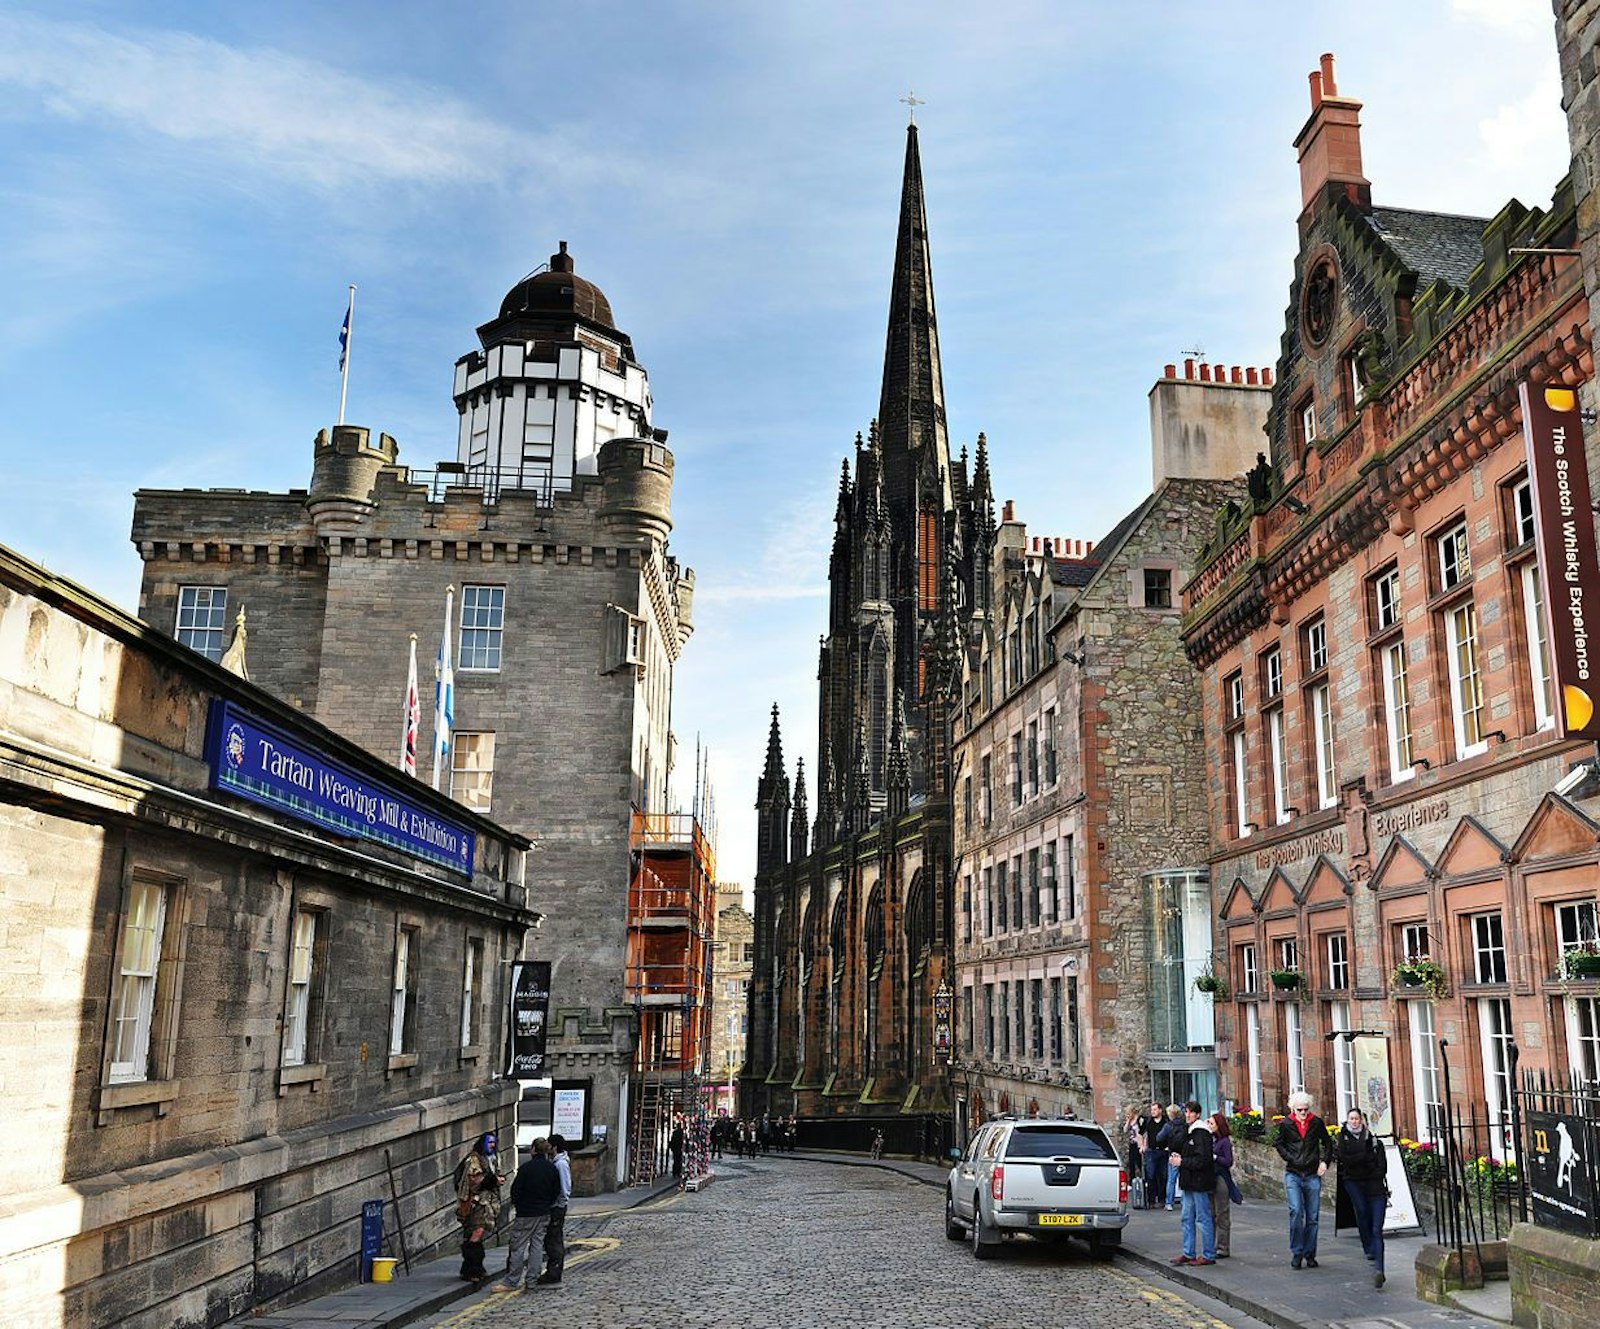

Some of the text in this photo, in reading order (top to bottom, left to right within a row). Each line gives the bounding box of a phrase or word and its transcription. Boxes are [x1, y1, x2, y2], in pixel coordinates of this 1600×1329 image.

[1552, 426, 1590, 680] The Scotch Whisky Experience
[258, 738, 314, 792] Tartan
[319, 768, 378, 824] Weaving
[379, 798, 400, 829] Mill
[400, 810, 409, 833] &
[410, 813, 457, 854] Exhibition
[1376, 800, 1449, 837] Experience
[1256, 829, 1344, 870] The Scotch Whisky
